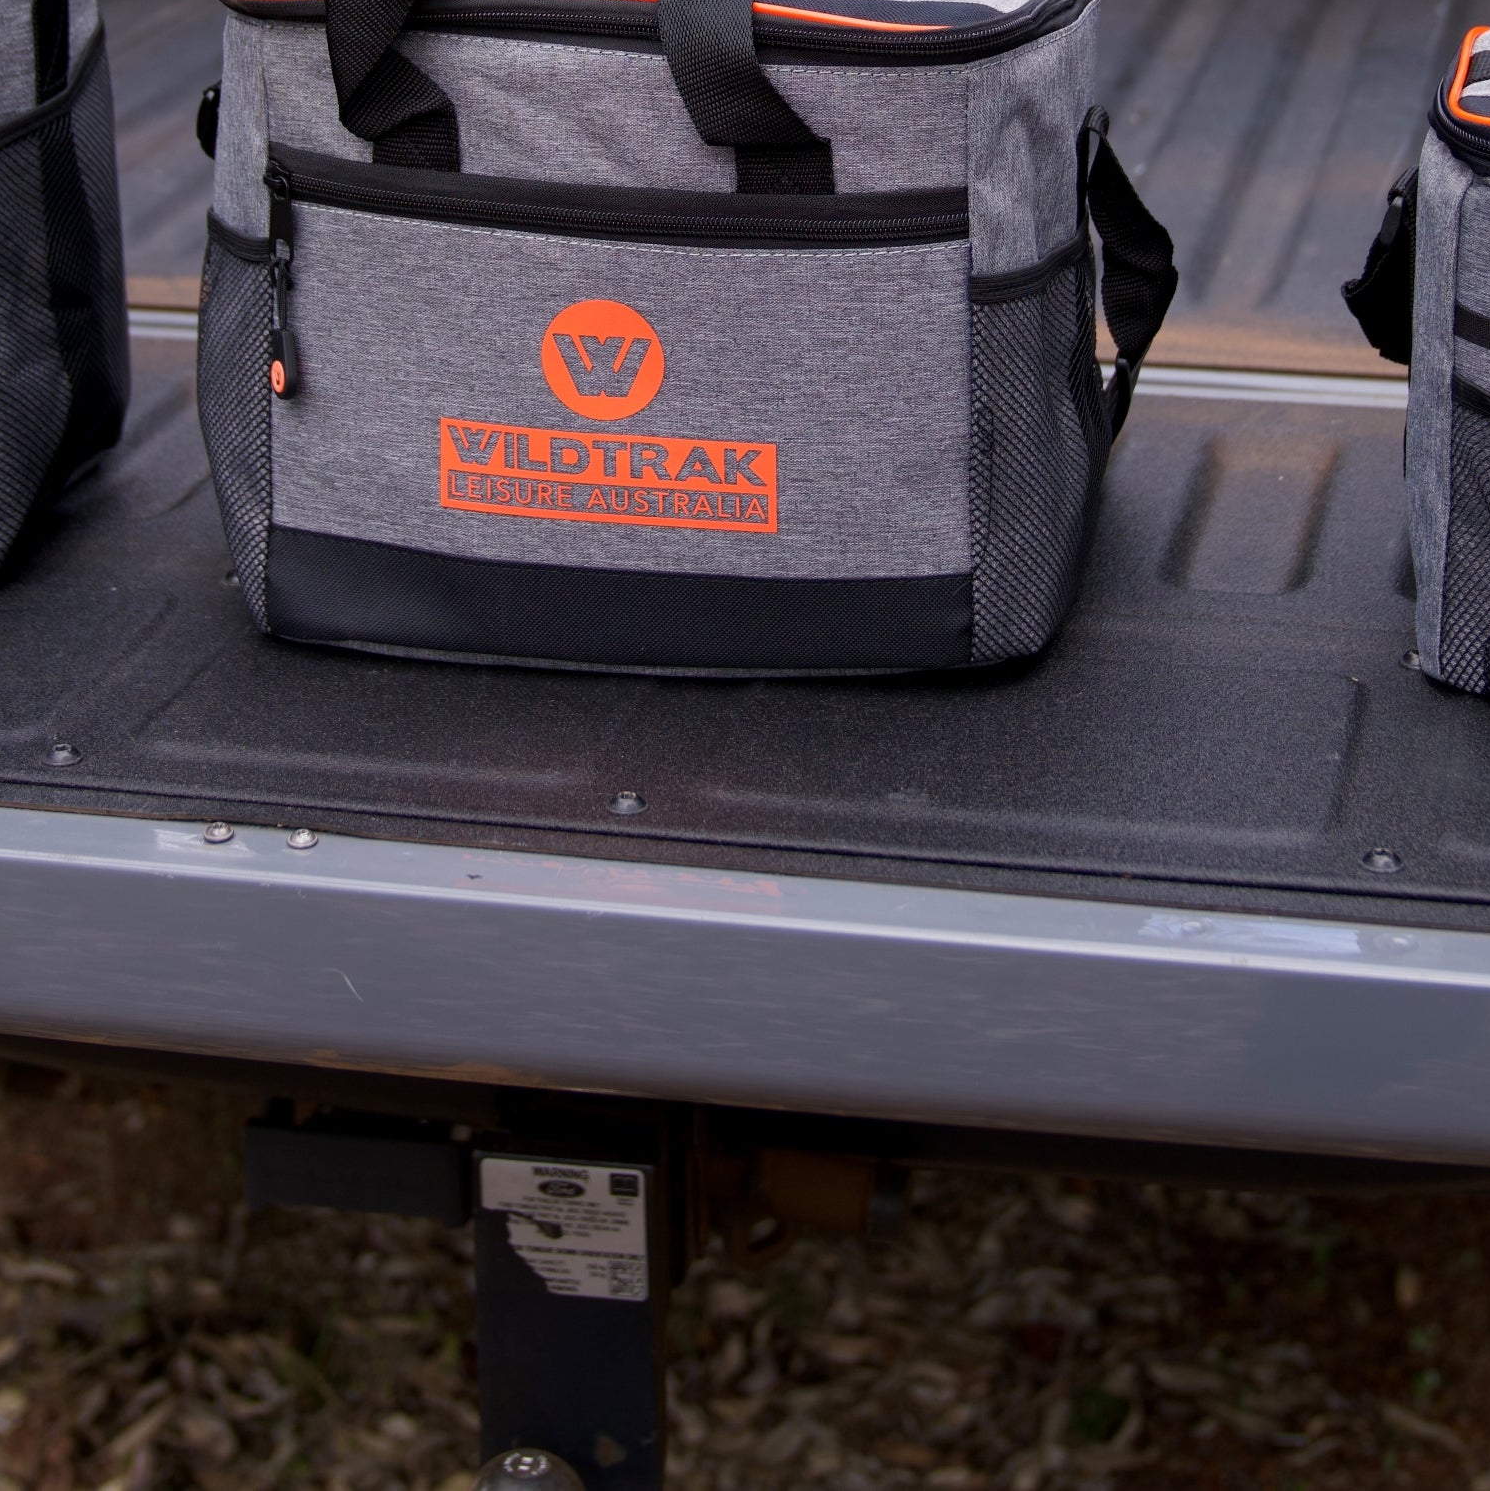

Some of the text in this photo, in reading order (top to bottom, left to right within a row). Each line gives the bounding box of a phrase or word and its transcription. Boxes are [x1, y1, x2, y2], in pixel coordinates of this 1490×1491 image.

[447, 425, 767, 487] WILDTRAK
[451, 475, 767, 520] LEISURE AUSTRALIA
[531, 1166, 590, 1181] WARNING
